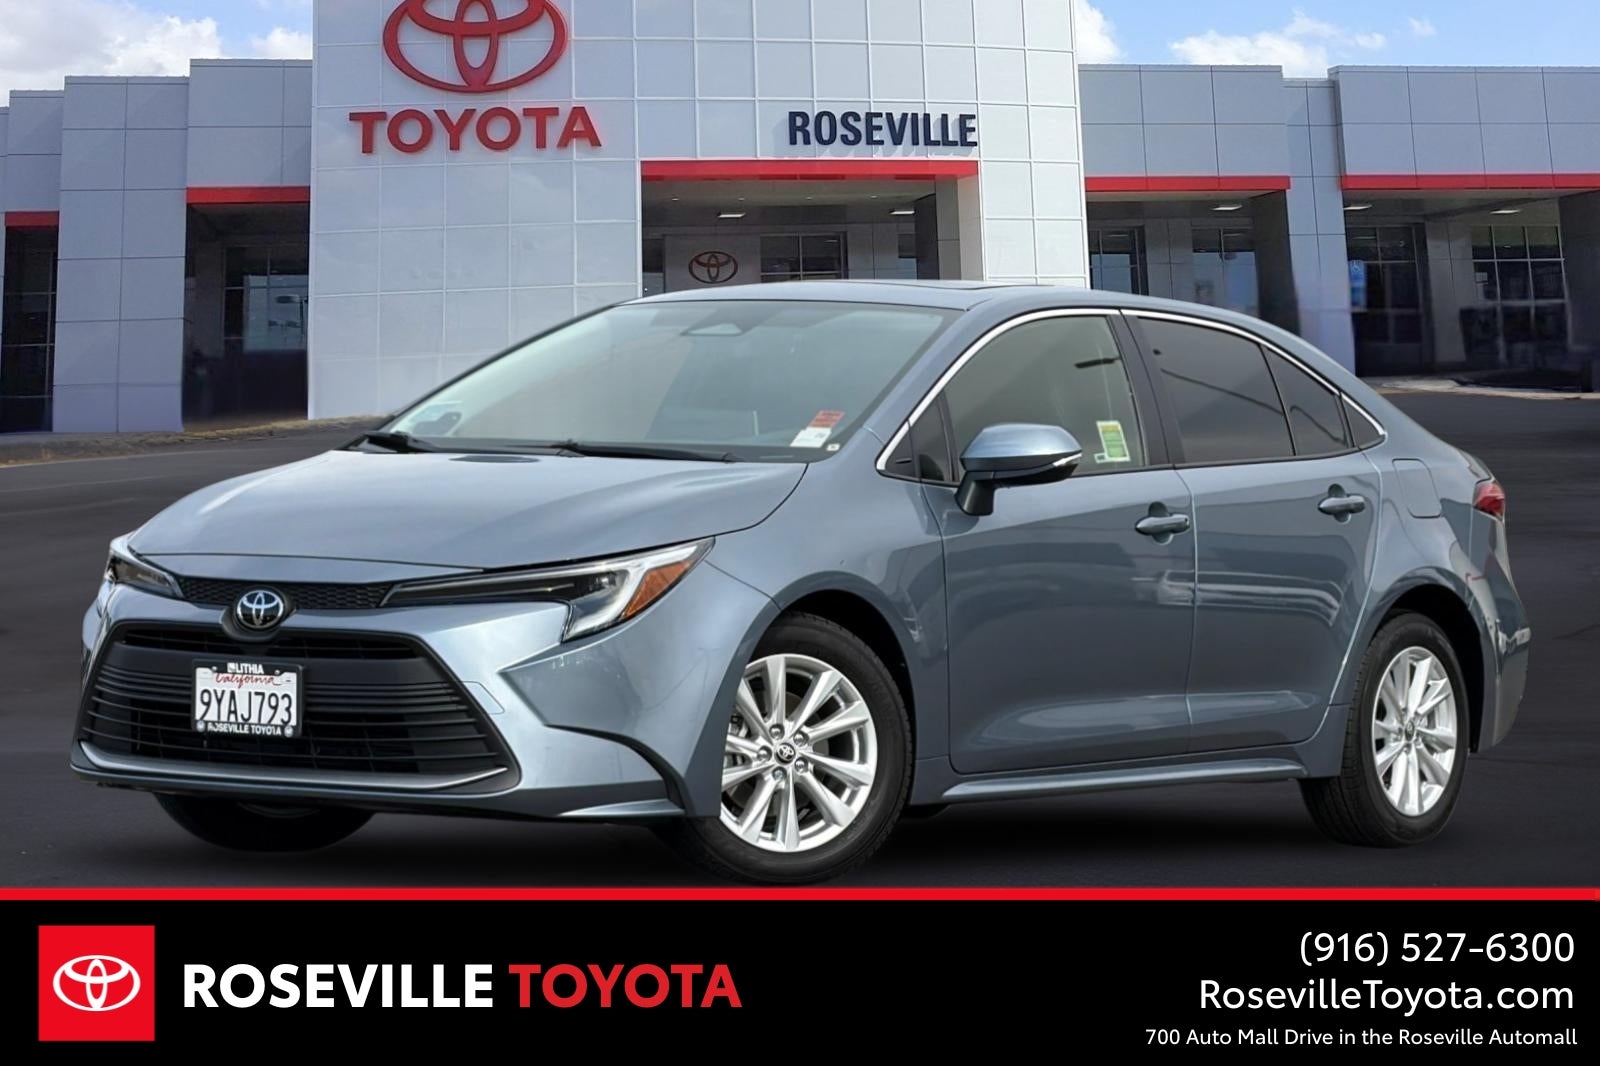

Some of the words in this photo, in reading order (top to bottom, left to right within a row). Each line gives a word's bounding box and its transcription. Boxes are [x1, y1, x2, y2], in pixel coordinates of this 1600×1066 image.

[349, 106, 602, 154] TOYOTA
[788, 110, 978, 147] ROSEVILLE
[215, 672, 275, 689] California
[236, 662, 265, 675] LITHIA
[200, 688, 293, 726] 9YAJ793
